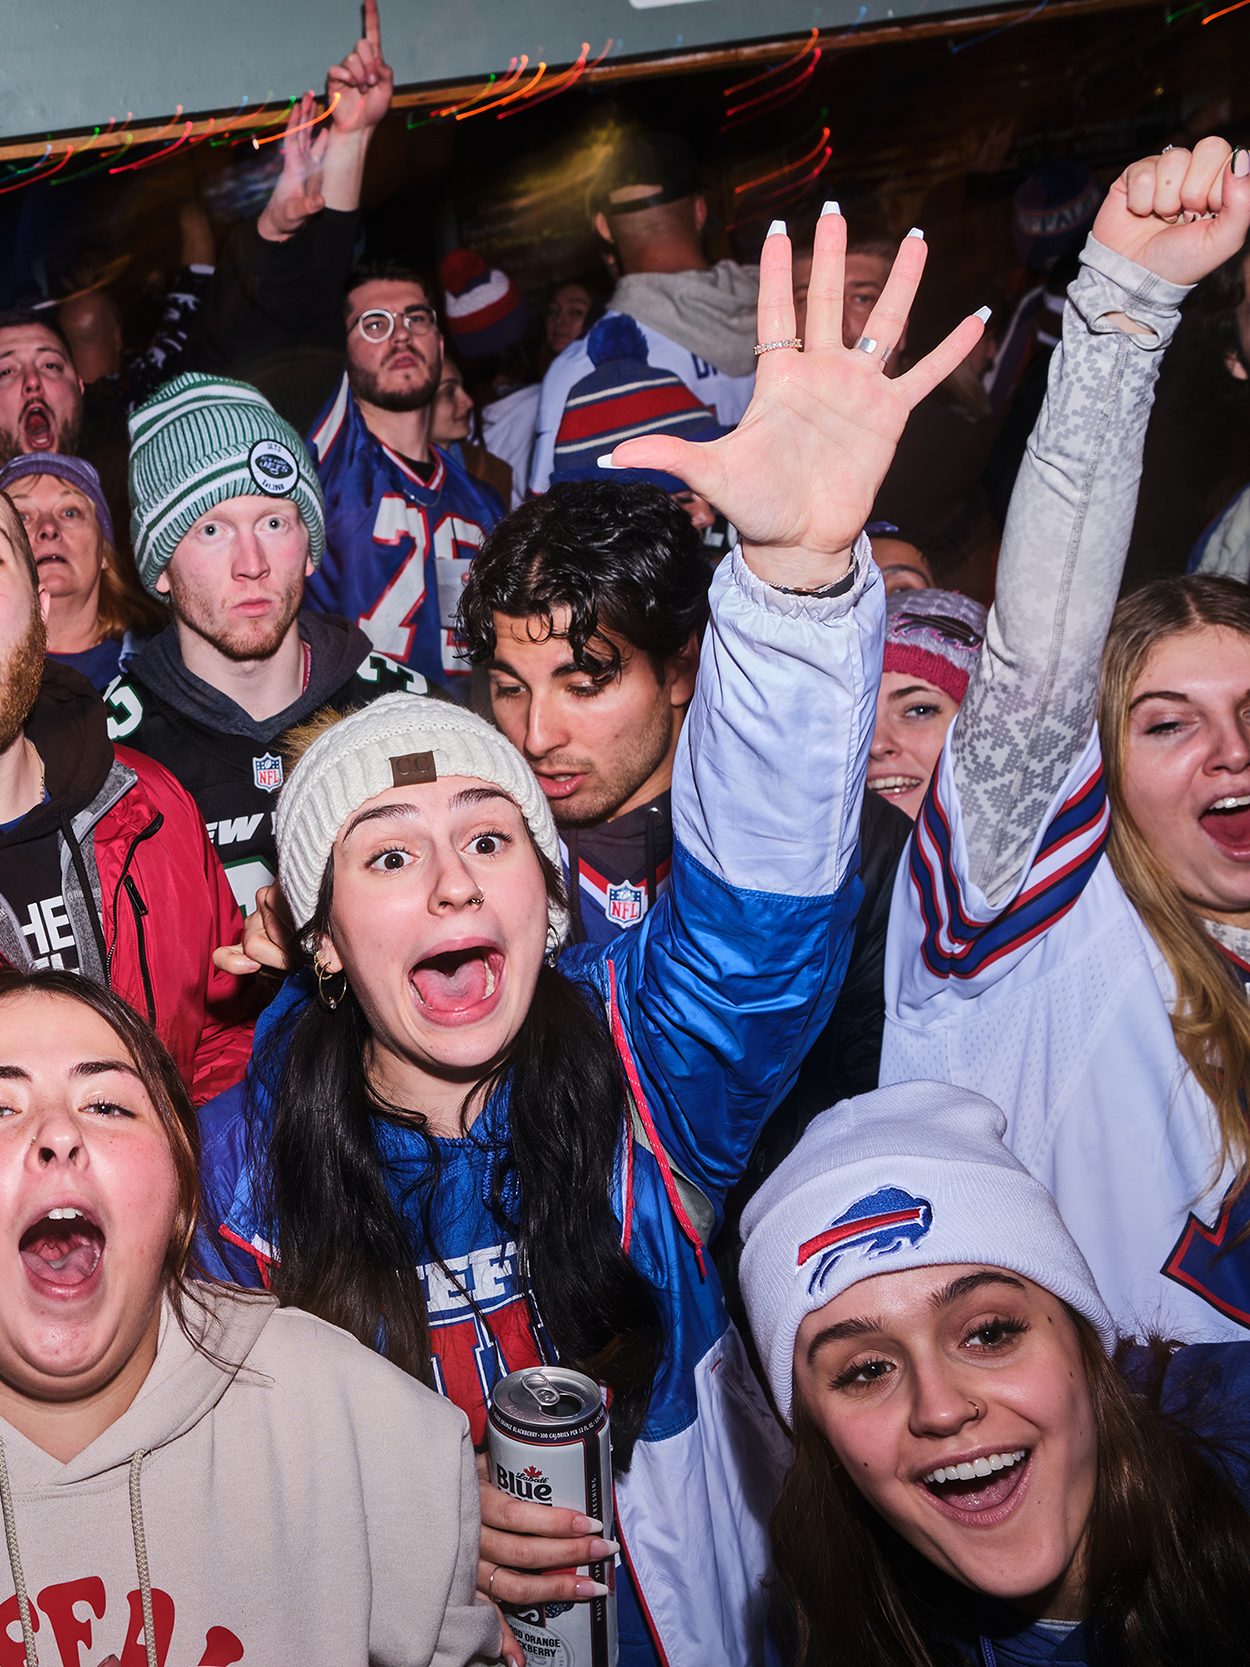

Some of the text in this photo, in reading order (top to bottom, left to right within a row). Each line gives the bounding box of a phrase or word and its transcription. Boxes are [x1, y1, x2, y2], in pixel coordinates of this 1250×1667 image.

[259, 460, 290, 473] JETS
[258, 770, 280, 785] NFL
[611, 901, 639, 920] NFL
[512, 1426, 538, 1438] BLACKBERRY
[549, 1431, 570, 1440] CALORIES
[496, 1462, 553, 1501] Blue
[515, 1472, 550, 1484] Labatt
[524, 1633, 561, 1648] ORANGE
